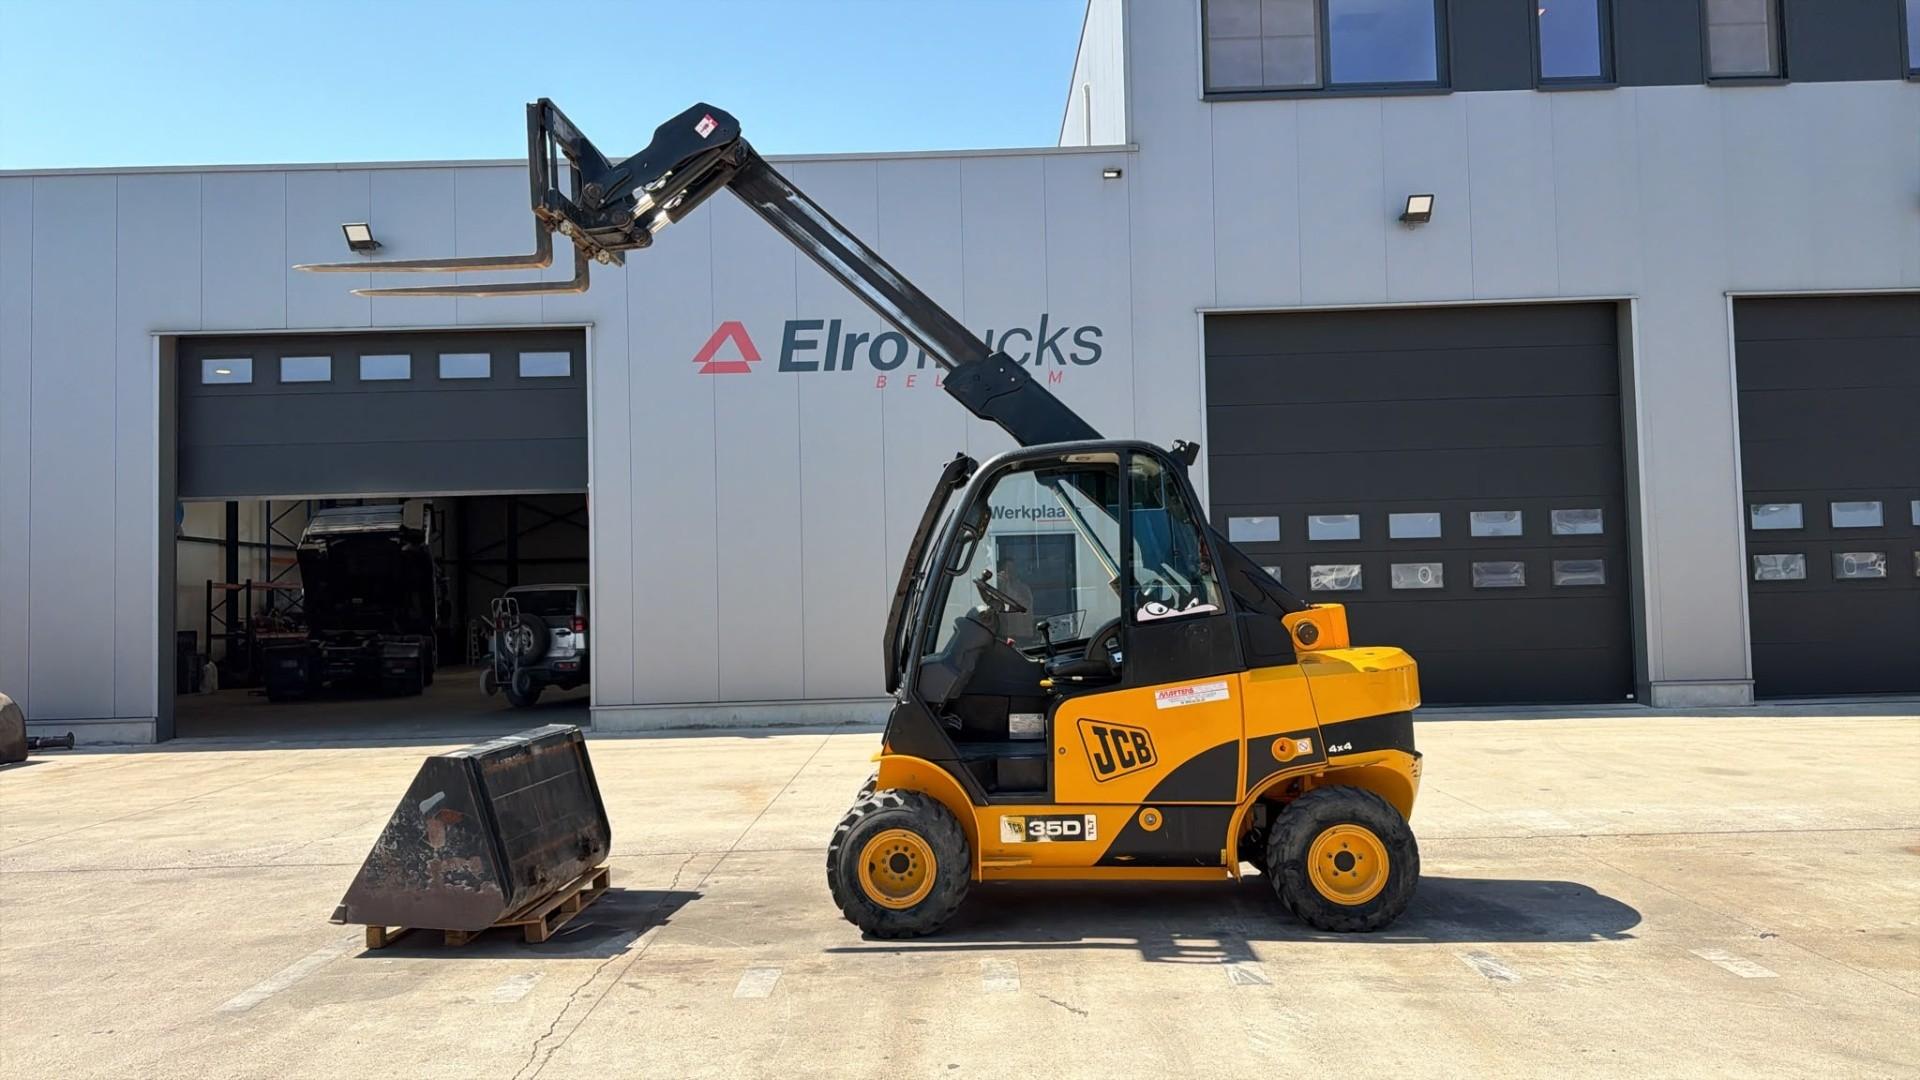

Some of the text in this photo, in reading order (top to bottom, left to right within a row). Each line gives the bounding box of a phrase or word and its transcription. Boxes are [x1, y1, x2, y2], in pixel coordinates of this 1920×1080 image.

[778, 313, 1104, 372] Elrocks
[875, 371, 1064, 388] BELM
[991, 504, 1081, 521] Werkplaa
[1091, 725, 1152, 775] JCB
[1328, 742, 1353, 753] 4x4
[1028, 820, 1081, 836] 35D
